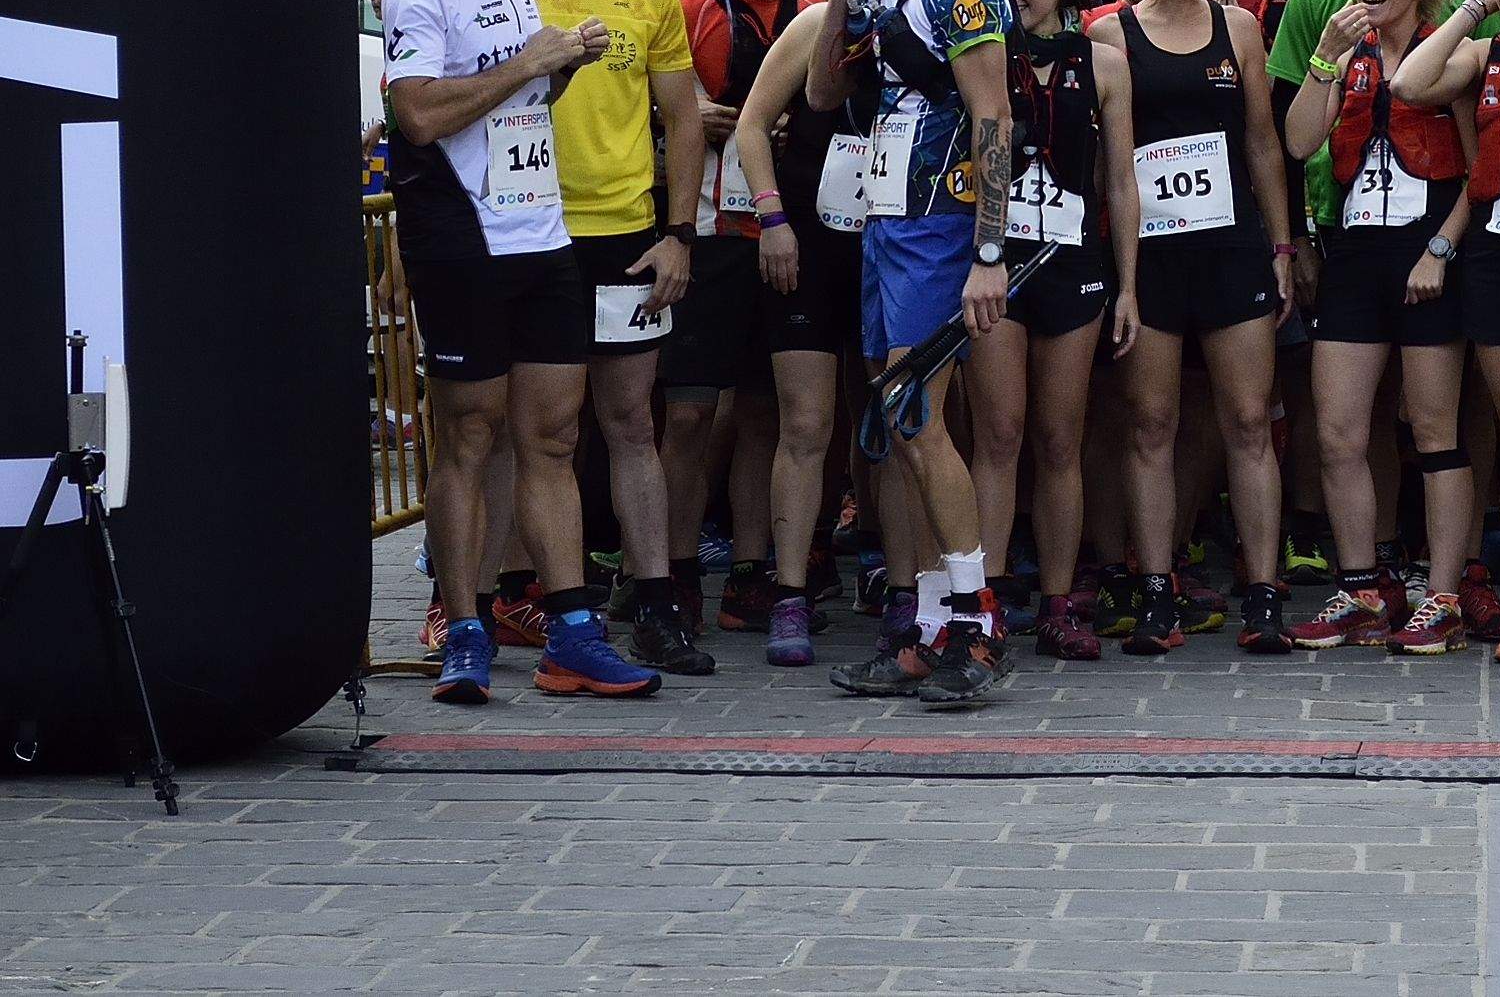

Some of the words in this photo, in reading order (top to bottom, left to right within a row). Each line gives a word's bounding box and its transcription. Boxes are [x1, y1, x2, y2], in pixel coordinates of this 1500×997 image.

[508, 138, 550, 172] 146
[870, 151, 888, 180] 41
[1146, 140, 1219, 162] INTERSPORT
[1009, 178, 1065, 210] 132
[1153, 168, 1212, 202] 105
[627, 303, 662, 331] 44
